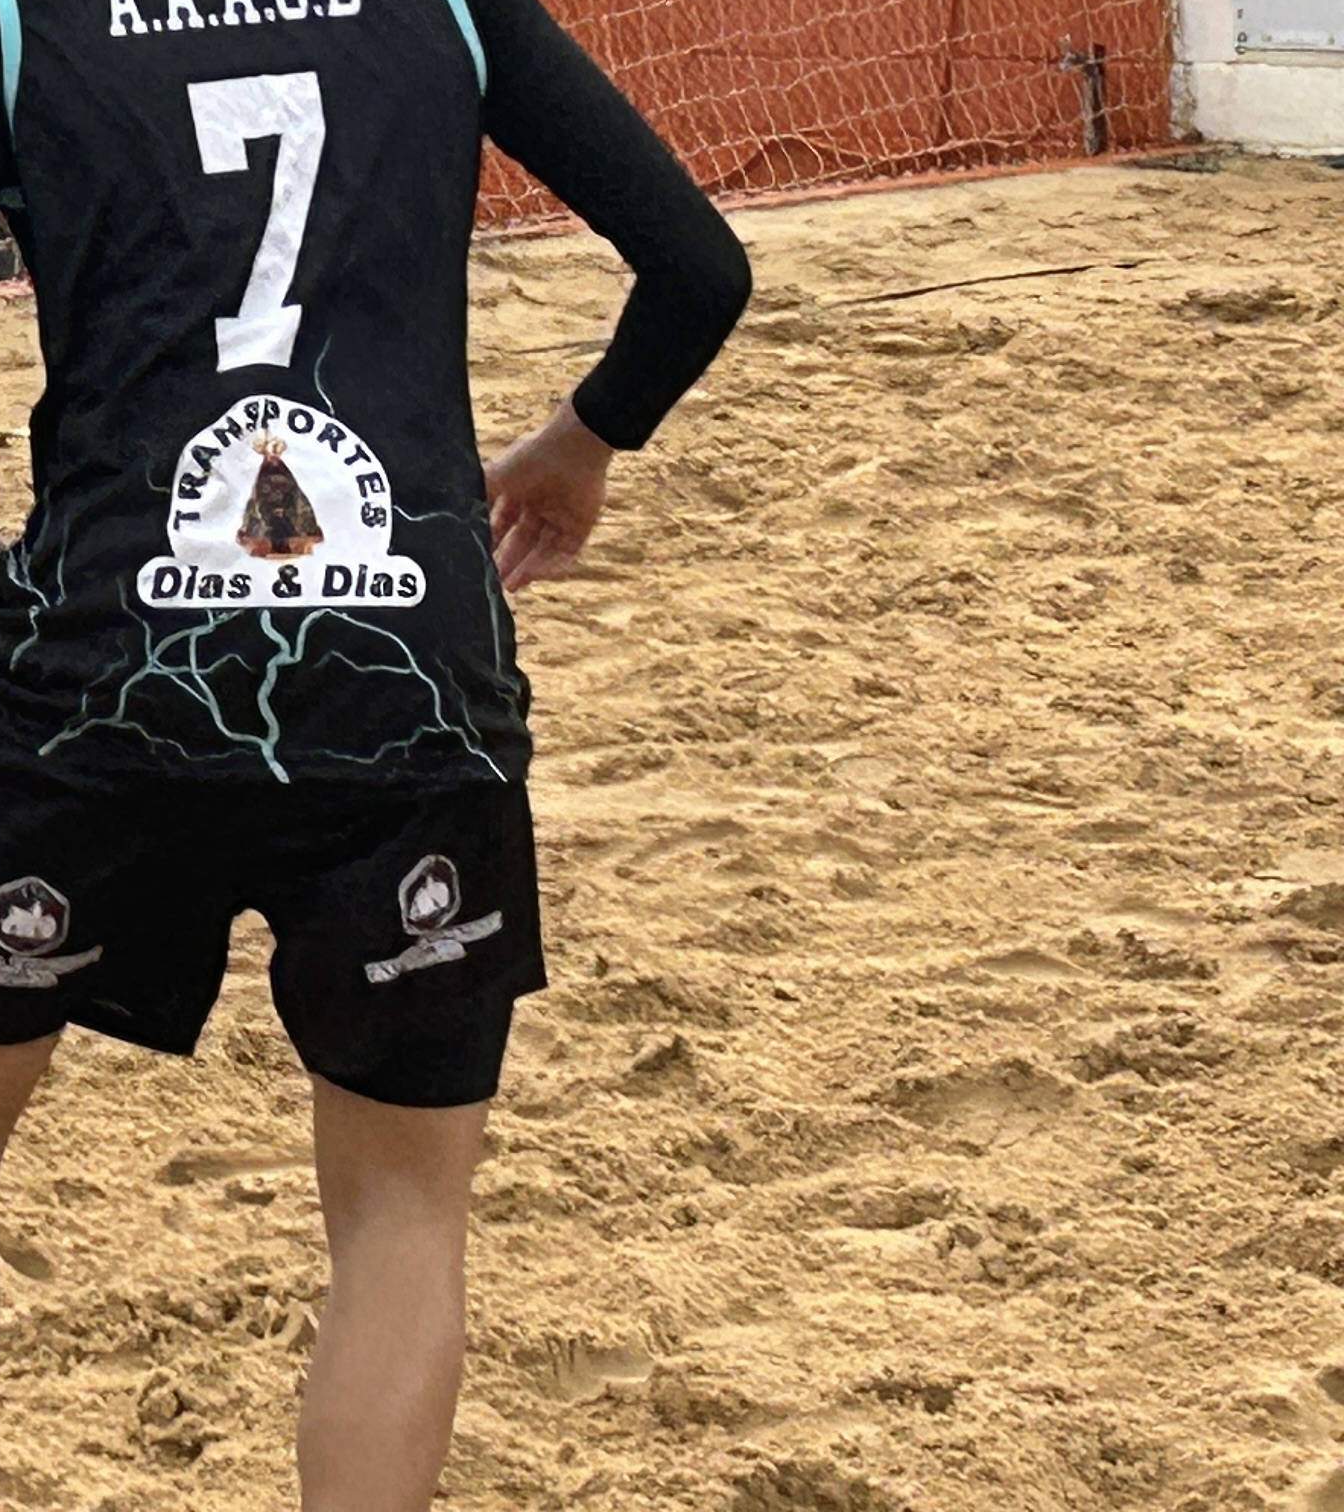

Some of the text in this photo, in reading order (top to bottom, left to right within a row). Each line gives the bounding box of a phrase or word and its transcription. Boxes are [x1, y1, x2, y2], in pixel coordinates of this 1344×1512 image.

[187, 71, 326, 373] 7
[173, 399, 387, 530] TRANSPORTES
[151, 564, 418, 599] Dias & Dias
